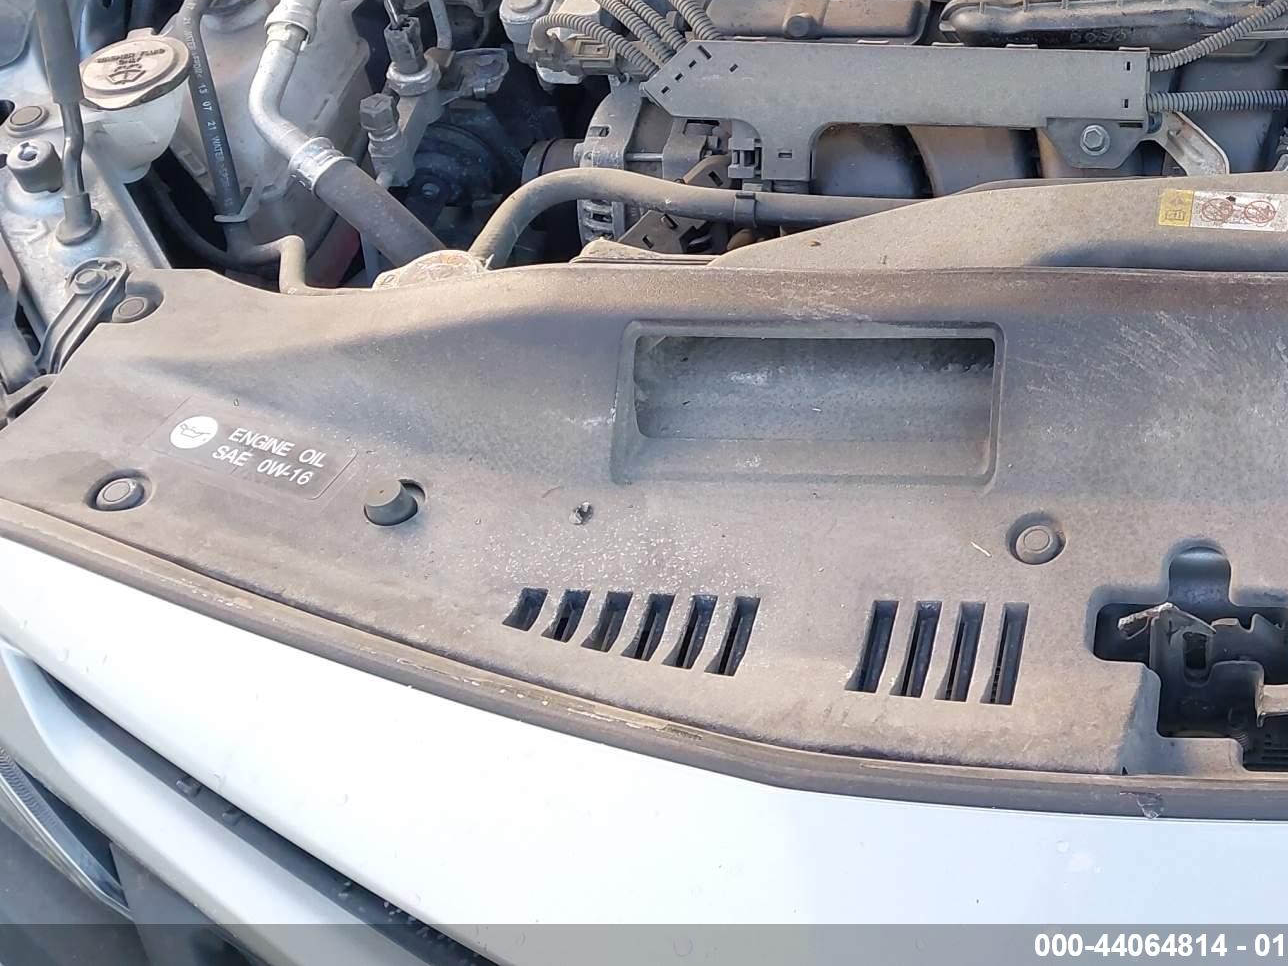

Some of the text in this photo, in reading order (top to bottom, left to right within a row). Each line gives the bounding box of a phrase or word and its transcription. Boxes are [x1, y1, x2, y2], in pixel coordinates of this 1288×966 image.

[207, 120, 217, 130] 21
[210, 135, 225, 163] WATER
[228, 427, 329, 468] ENGINE OIL
[211, 445, 315, 486] SAE 0W-16
